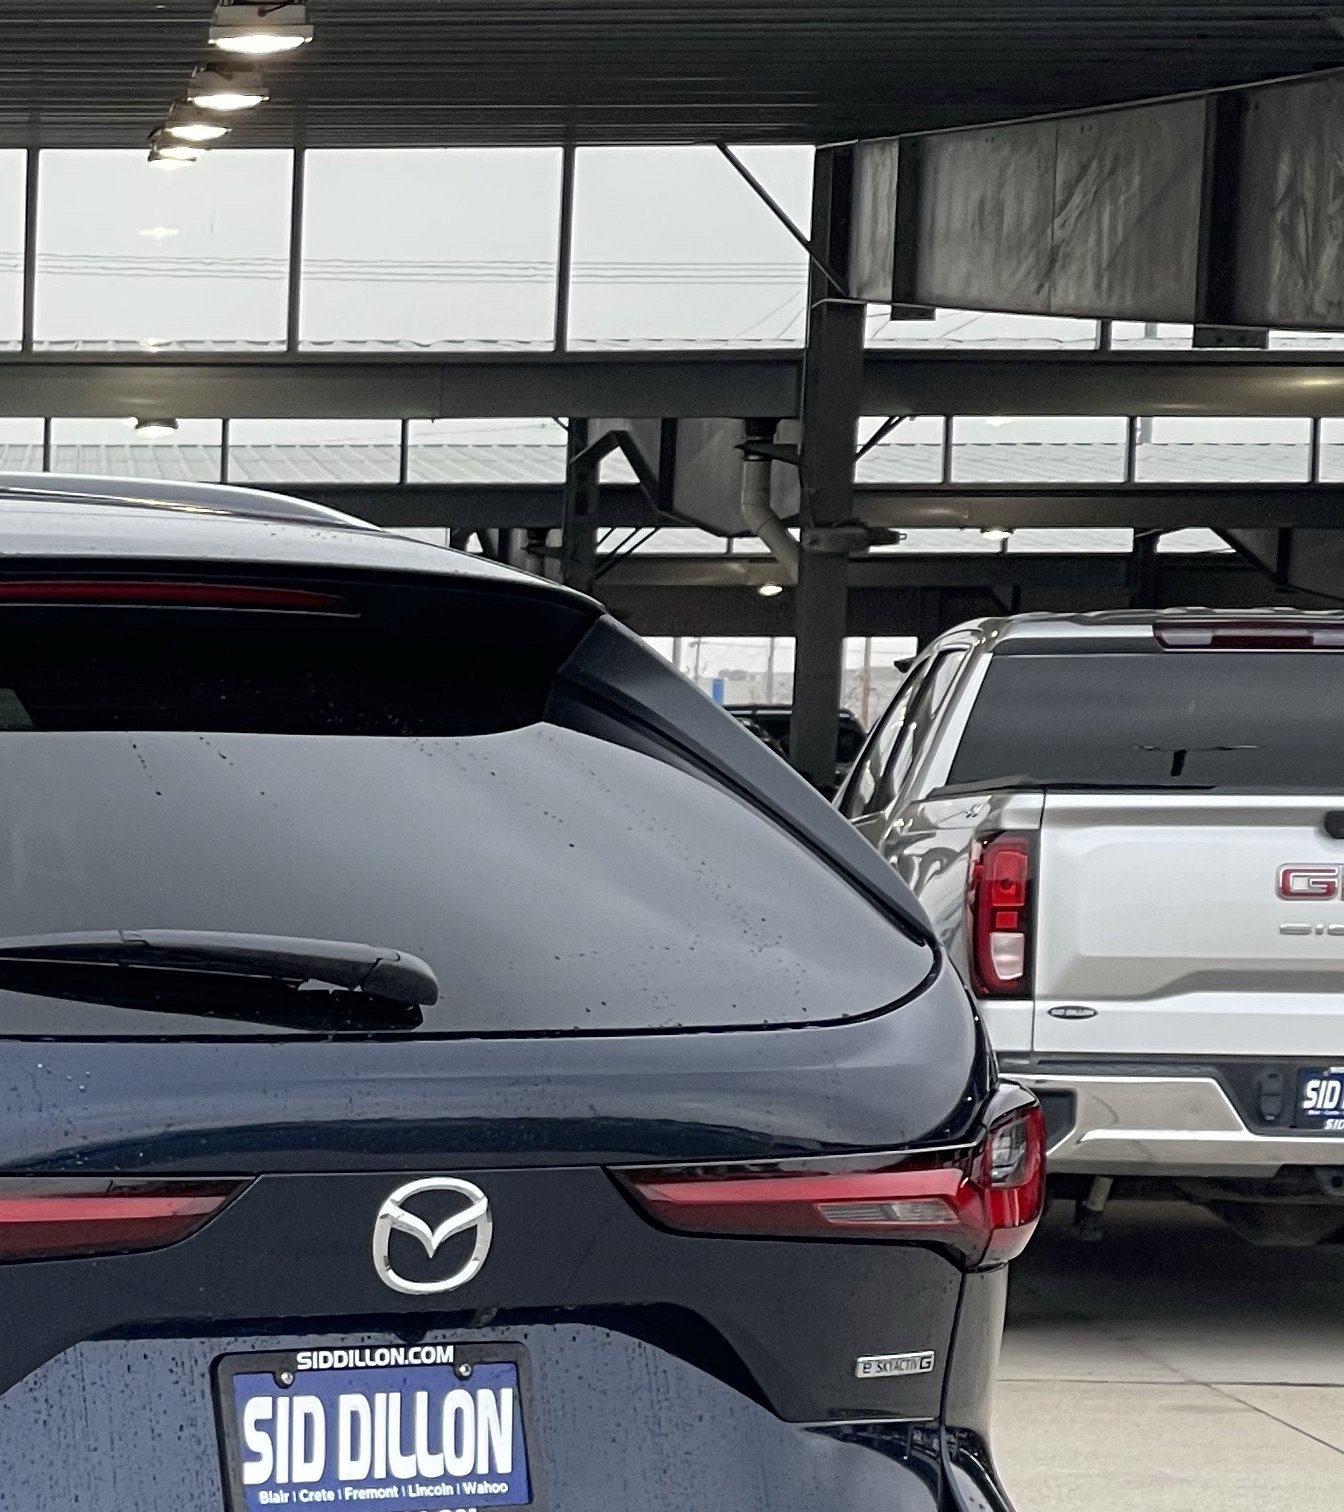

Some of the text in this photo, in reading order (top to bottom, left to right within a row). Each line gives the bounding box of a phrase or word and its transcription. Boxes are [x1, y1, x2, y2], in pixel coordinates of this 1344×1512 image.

[1276, 863, 1344, 901] G
[1303, 1079, 1341, 1109] SID
[297, 1346, 454, 1369] SIDDILLON.COM
[243, 1388, 513, 1485] SID DILLON
[259, 1481, 508, 1504] Blair Crete Fremont Lincoln Wahoo
